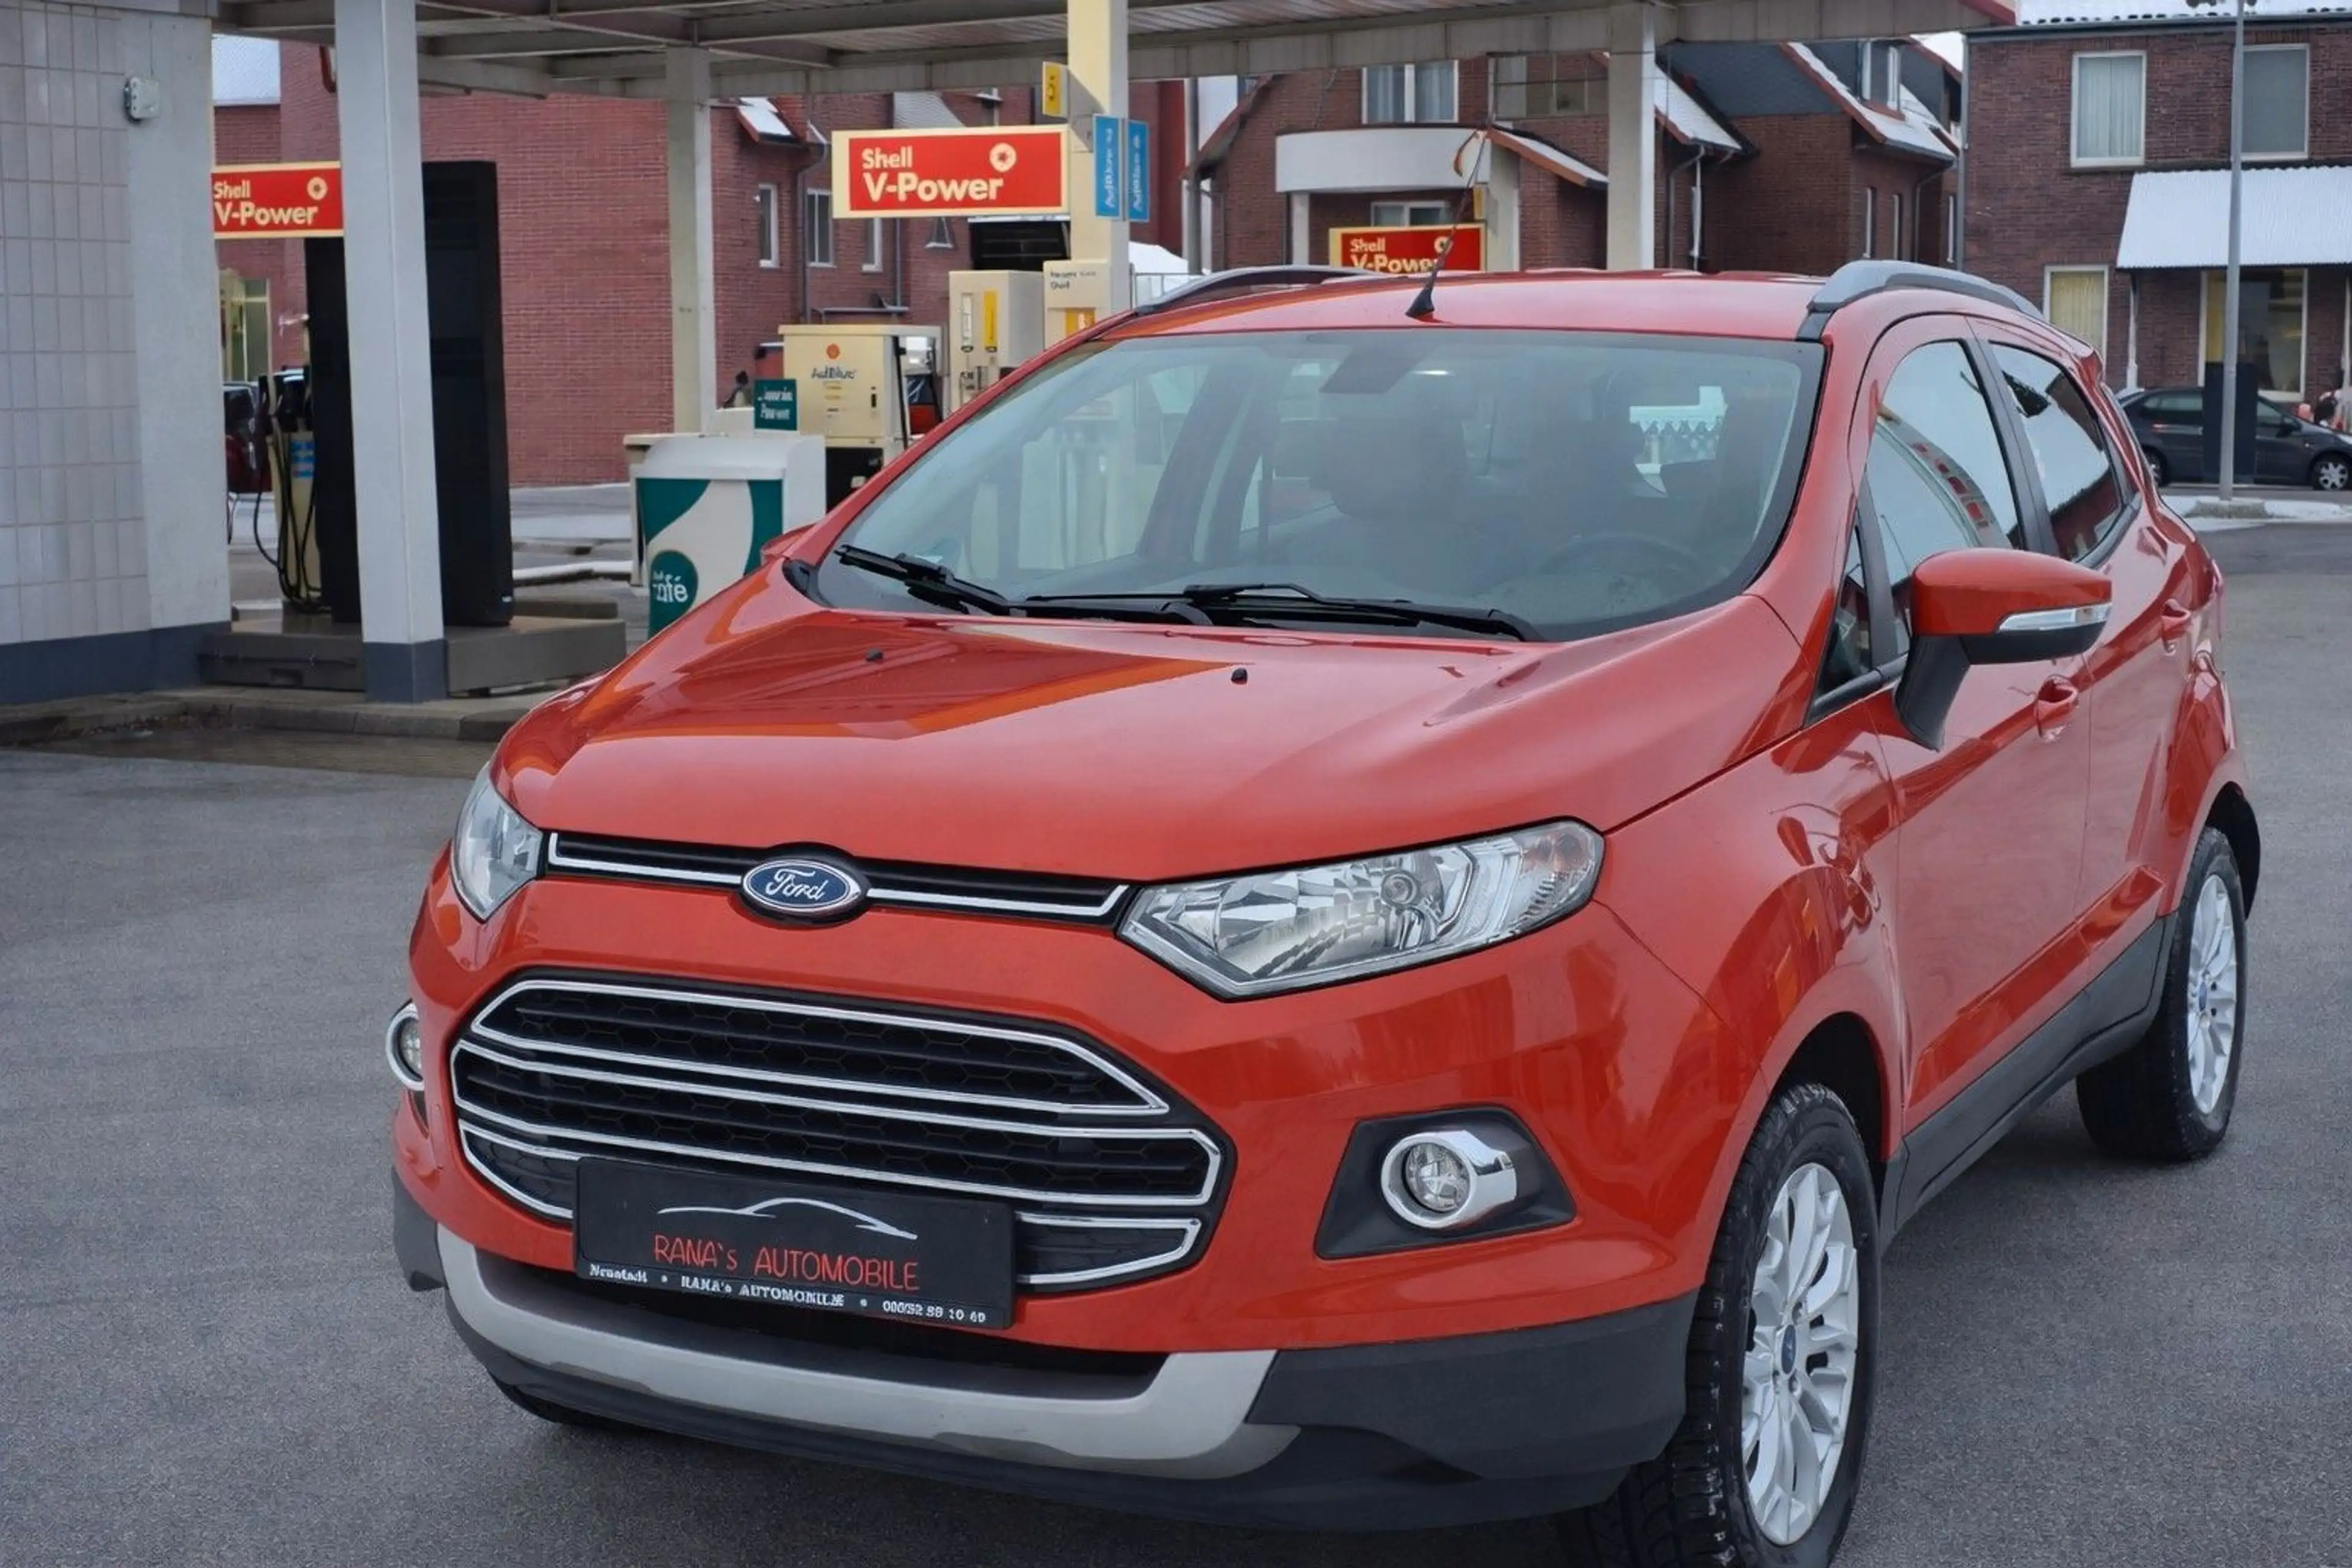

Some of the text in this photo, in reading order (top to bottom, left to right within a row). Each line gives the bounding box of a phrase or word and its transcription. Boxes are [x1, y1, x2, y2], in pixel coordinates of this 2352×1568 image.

[862, 146, 913, 170] Shell
[213, 180, 251, 200] Shell
[863, 172, 1003, 202] V-Power
[214, 201, 318, 226] V-Power
[1350, 237, 1385, 252] Shell
[766, 868, 828, 900] Ford
[755, 1246, 919, 1291] AUTOMOBILE
